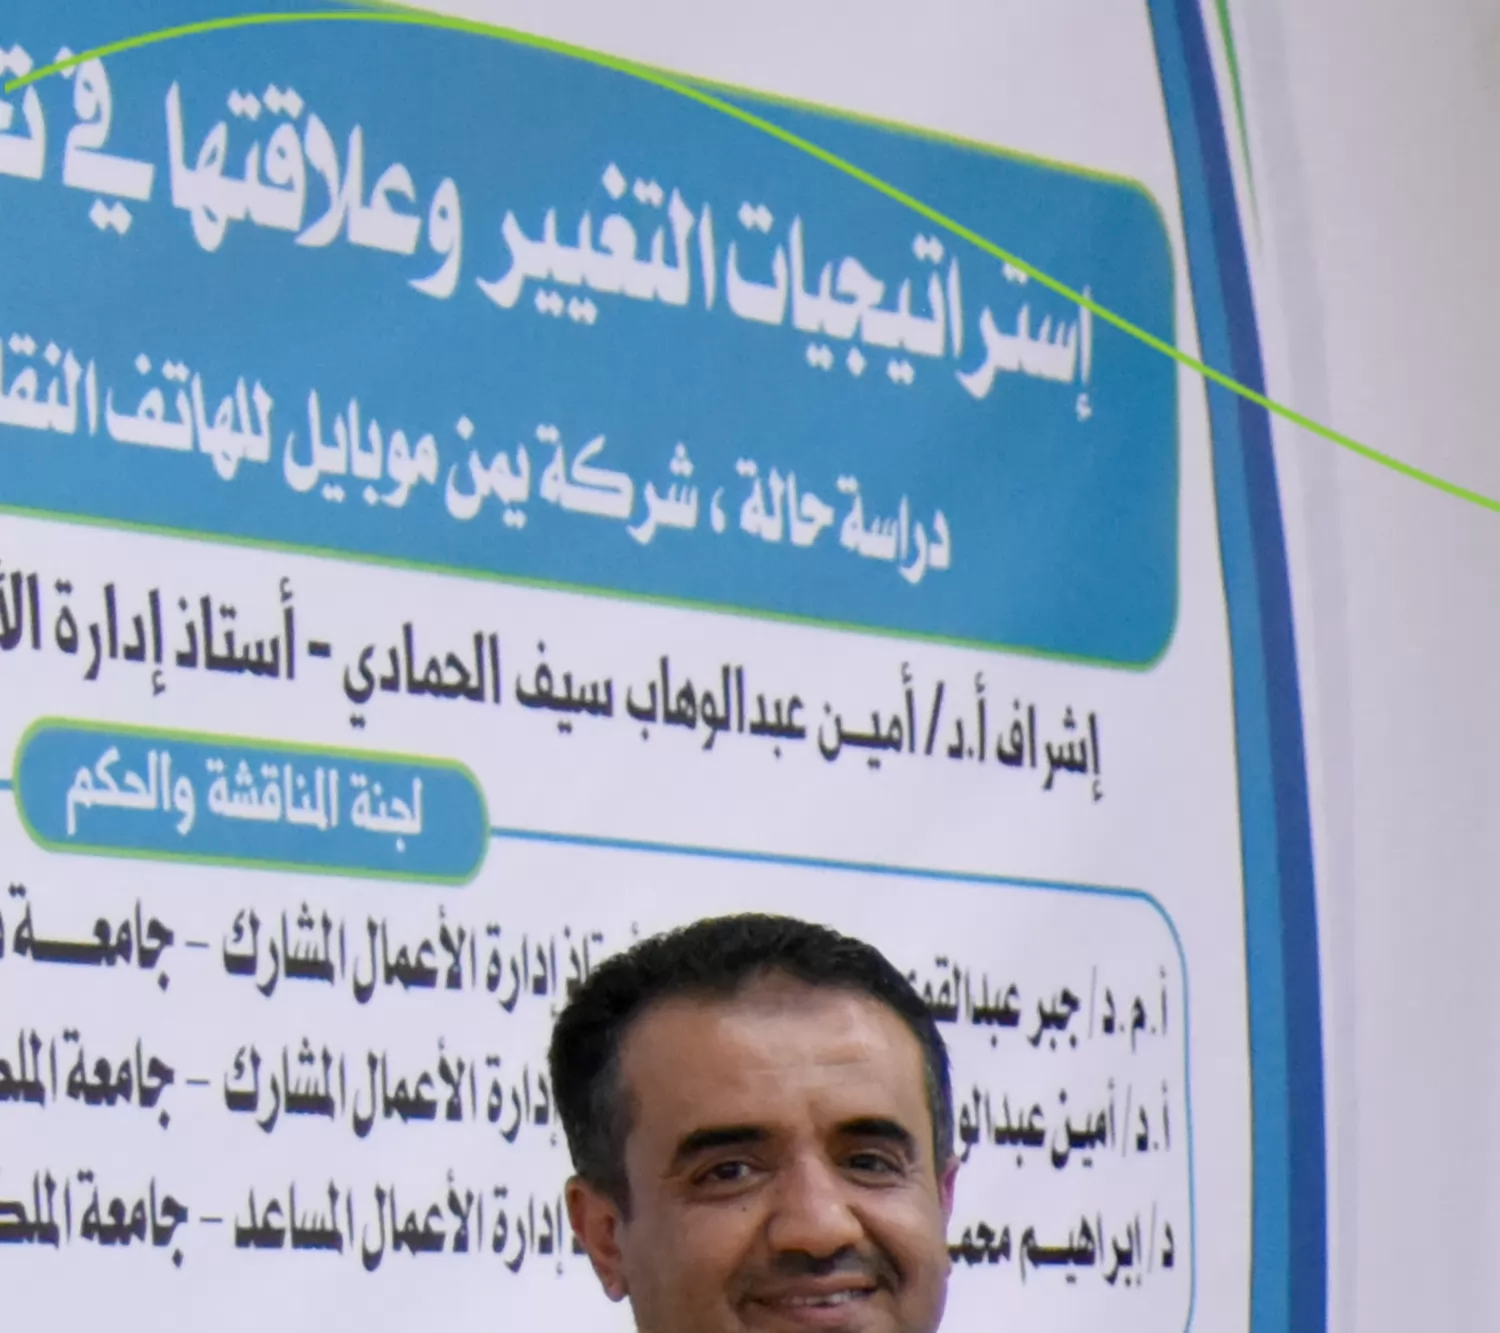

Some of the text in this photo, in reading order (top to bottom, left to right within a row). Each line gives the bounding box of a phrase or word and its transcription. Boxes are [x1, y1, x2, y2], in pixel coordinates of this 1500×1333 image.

[54, 46, 155, 235] في
[165, 80, 463, 299] وعلاقتها
[476, 162, 717, 324] التغيير
[0, 333, 98, 437] النق
[104, 353, 272, 480] للهاتف
[283, 388, 439, 508] موبايل
[445, 414, 531, 529] يمن
[536, 424, 698, 544] شركة
[736, 458, 834, 547] حالة
[839, 475, 951, 584] دراسة
[54, 579, 166, 698] إدارة
[176, 576, 296, 680] أستاذ
[343, 622, 501, 730] الحمادي
[515, 640, 613, 735] سيف
[625, 655, 806, 759] عبدالوهاب
[66, 746, 423, 852] لجنة المناقشة والحكم
[998, 693, 1104, 802] إشراف
[9, 882, 175, 993] جامعة
[222, 900, 346, 998] المشارك
[352, 904, 476, 1004] الأعمال
[0, 1027, 57, 1108] المل
[1028, 985, 1081, 1051] جبر
[62, 1028, 175, 1129] جامعة
[224, 1037, 346, 1134] المشارك
[352, 1037, 476, 1139] الأعمال
[956, 1085, 1046, 1169] عبدالو
[1051, 1078, 1115, 1169] أمين
[76, 1169, 189, 1268] جامعة
[235, 1180, 354, 1255] المساعد
[361, 1167, 484, 1273] الأعمال
[491, 1186, 564, 1278] إدارة
[947, 1215, 1011, 1268] محم
[1020, 1211, 1142, 1288] إبراهيم
